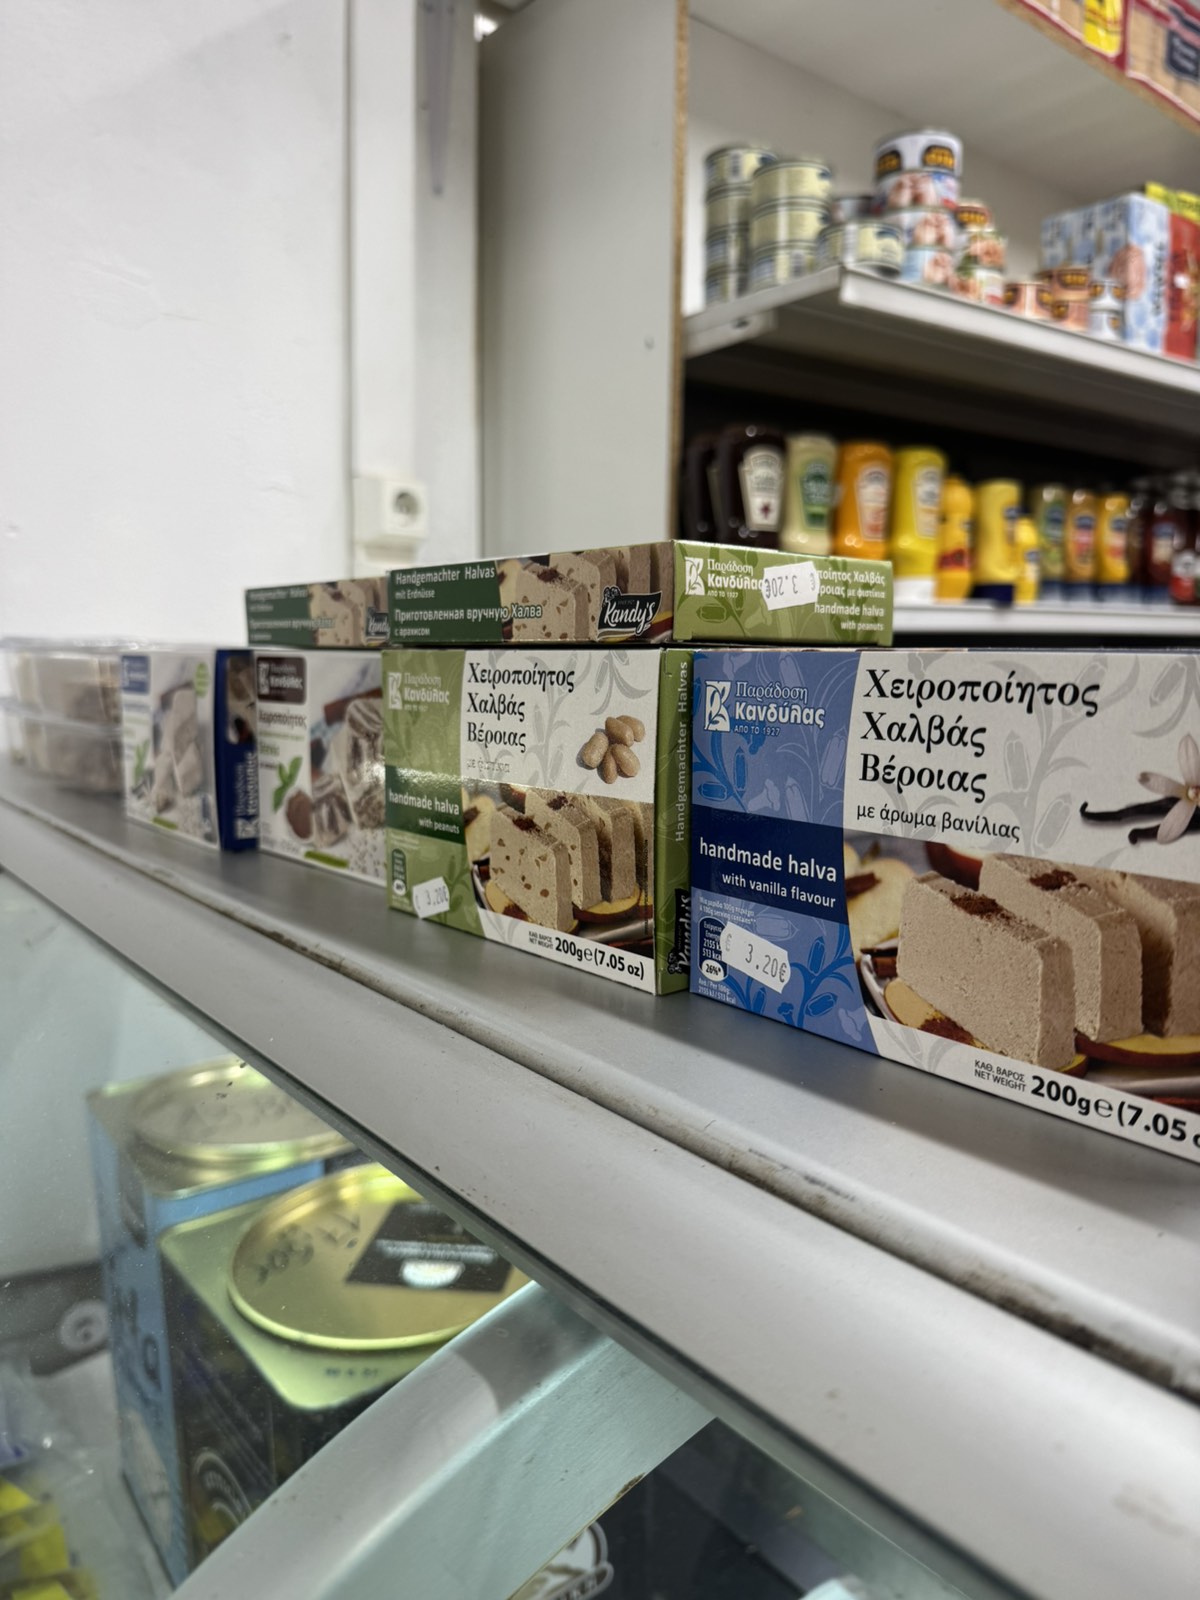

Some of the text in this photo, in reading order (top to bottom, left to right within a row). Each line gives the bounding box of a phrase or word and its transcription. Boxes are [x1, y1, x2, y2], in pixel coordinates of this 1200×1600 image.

[395, 564, 495, 587] Handgemachter Halvas
[707, 558, 754, 576] Παράδοση
[853, 571, 885, 586] Χαλβάς
[395, 588, 435, 599] mit Erdnüsse
[820, 585, 845, 598] ροιας
[394, 604, 543, 622] Приготовленная вручную Халва
[814, 603, 884, 617] handmade halva
[841, 620, 884, 631] with peanuts
[467, 662, 575, 693] Χειροποίητος
[735, 681, 808, 704] Παράδοση
[863, 668, 1101, 717] Χειροποίητος
[466, 692, 526, 723] Χαλβάς
[735, 701, 826, 729] Κανδύλας
[466, 721, 526, 753] Βέροιας
[734, 724, 780, 736] ΑΠΟ ΤΟ 1927
[860, 710, 987, 758] Χαλβάς
[675, 661, 689, 842] Handgemachter Halvas
[858, 752, 988, 804] Βέροιας
[389, 788, 460, 815] handmade halva
[419, 818, 460, 834] with peanuts
[856, 803, 1021, 843] με άρωμα βανίλιας
[699, 837, 837, 882] handmade halva
[722, 873, 837, 909] with vanilla flavour
[702, 947, 712, 959] 513
[703, 938, 716, 949] 2155
[725, 933, 787, 983] € 3.20€
[627, 961, 645, 981] oz)
[974, 1059, 1025, 1083] ΚΑΘ. ΒΑΡΟΣ
[974, 1069, 1027, 1092] NET WEIGHT
